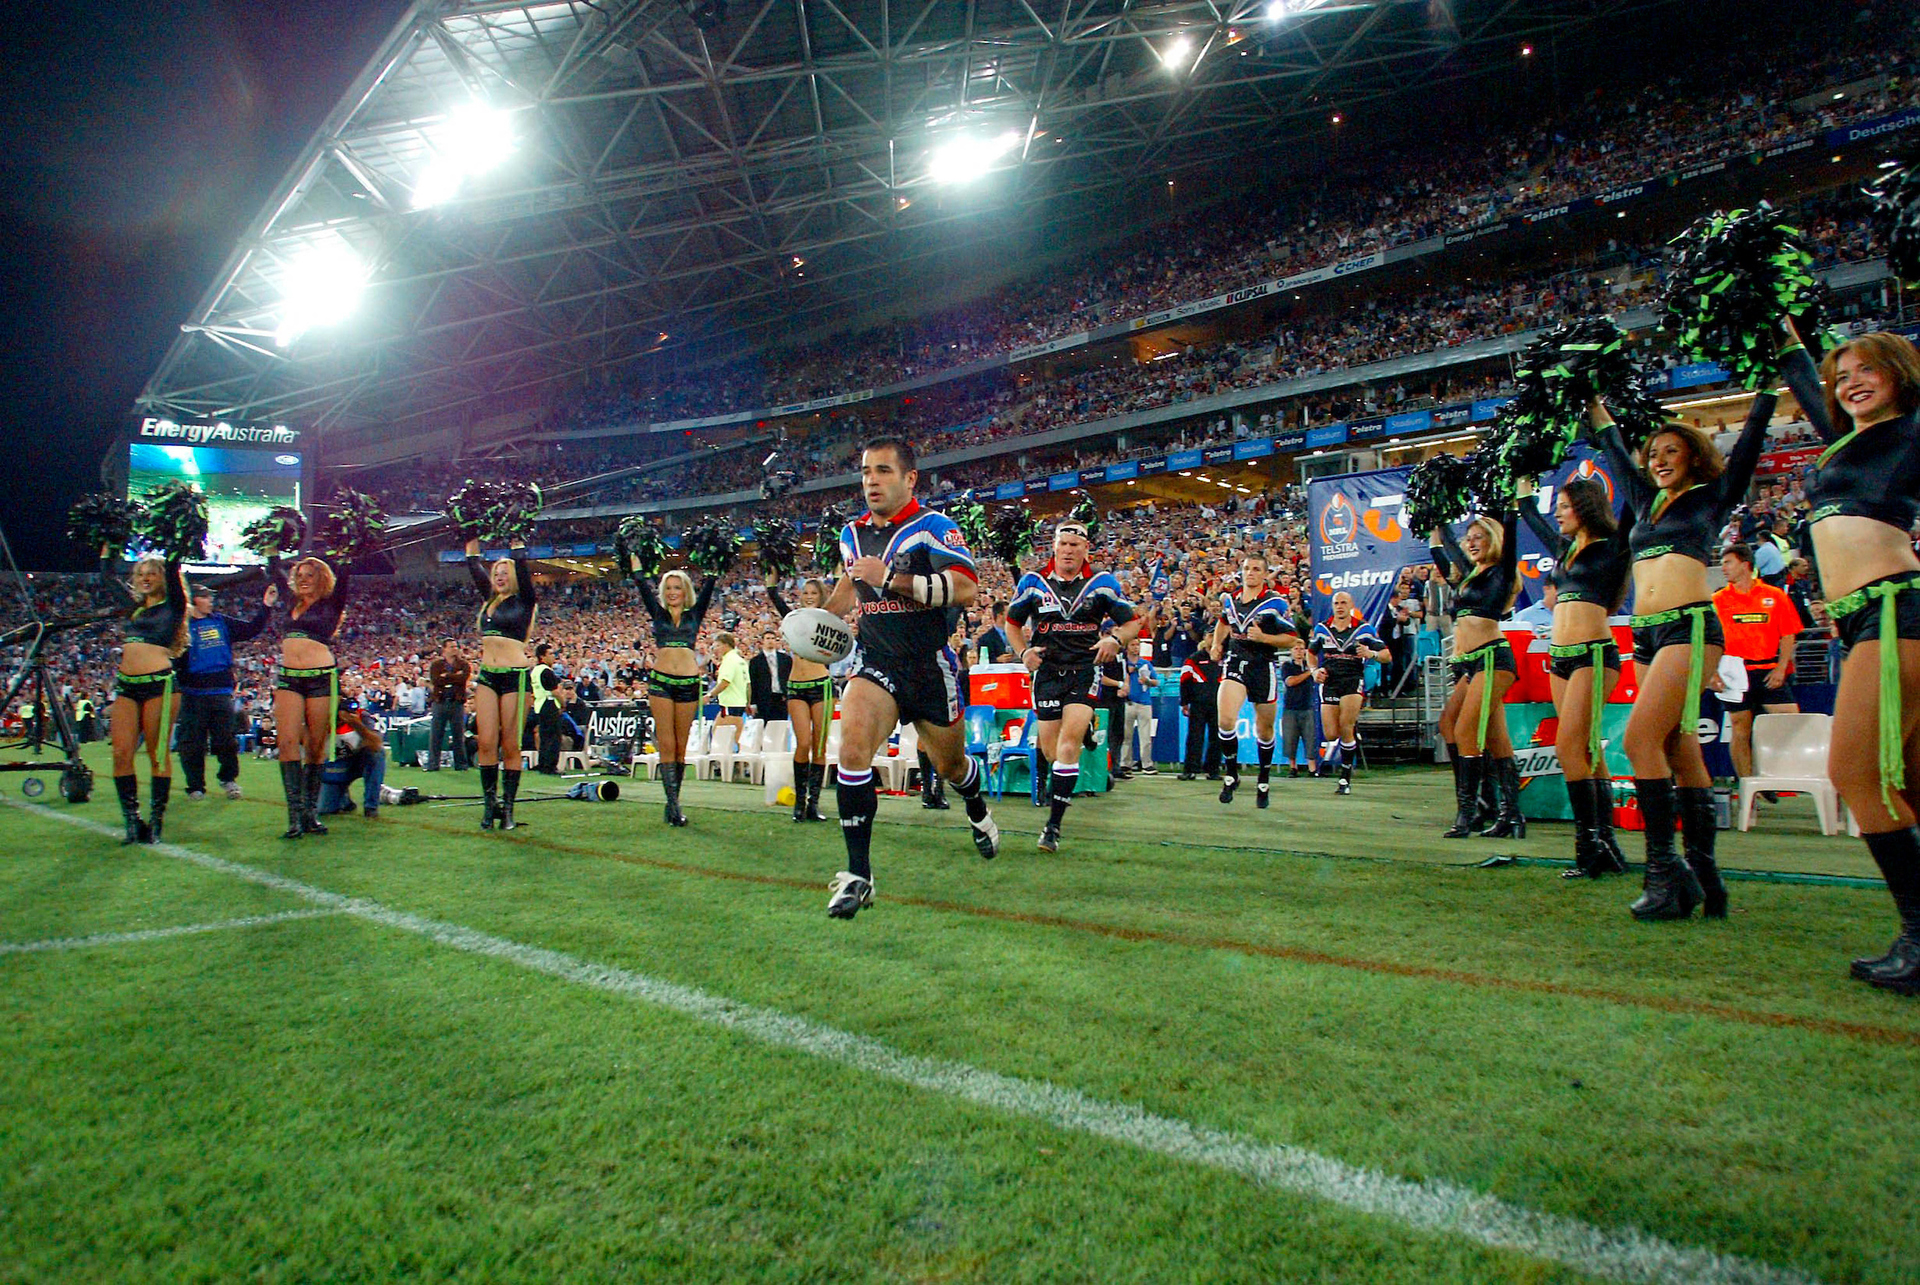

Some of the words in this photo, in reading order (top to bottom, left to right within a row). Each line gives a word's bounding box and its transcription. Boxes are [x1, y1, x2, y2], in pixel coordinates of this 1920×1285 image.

[1594, 185, 1644, 207] Telstra
[1522, 204, 1569, 225] Telstra
[1345, 257, 1375, 271] CHEP
[1234, 285, 1268, 302] CLIPSAL
[1176, 307, 1195, 315] Sony
[1434, 410, 1469, 423] Telstra
[140, 417, 295, 444] EnergyAustralia
[1351, 424, 1382, 436] Telstra
[1273, 437, 1304, 449] Telstra
[1320, 542, 1359, 555] TELSTRA
[1315, 569, 1394, 595] Telstra
[815, 623, 849, 644] GRAIN
[810, 635, 846, 655] NUTRI-
[588, 710, 656, 738] Austraa
